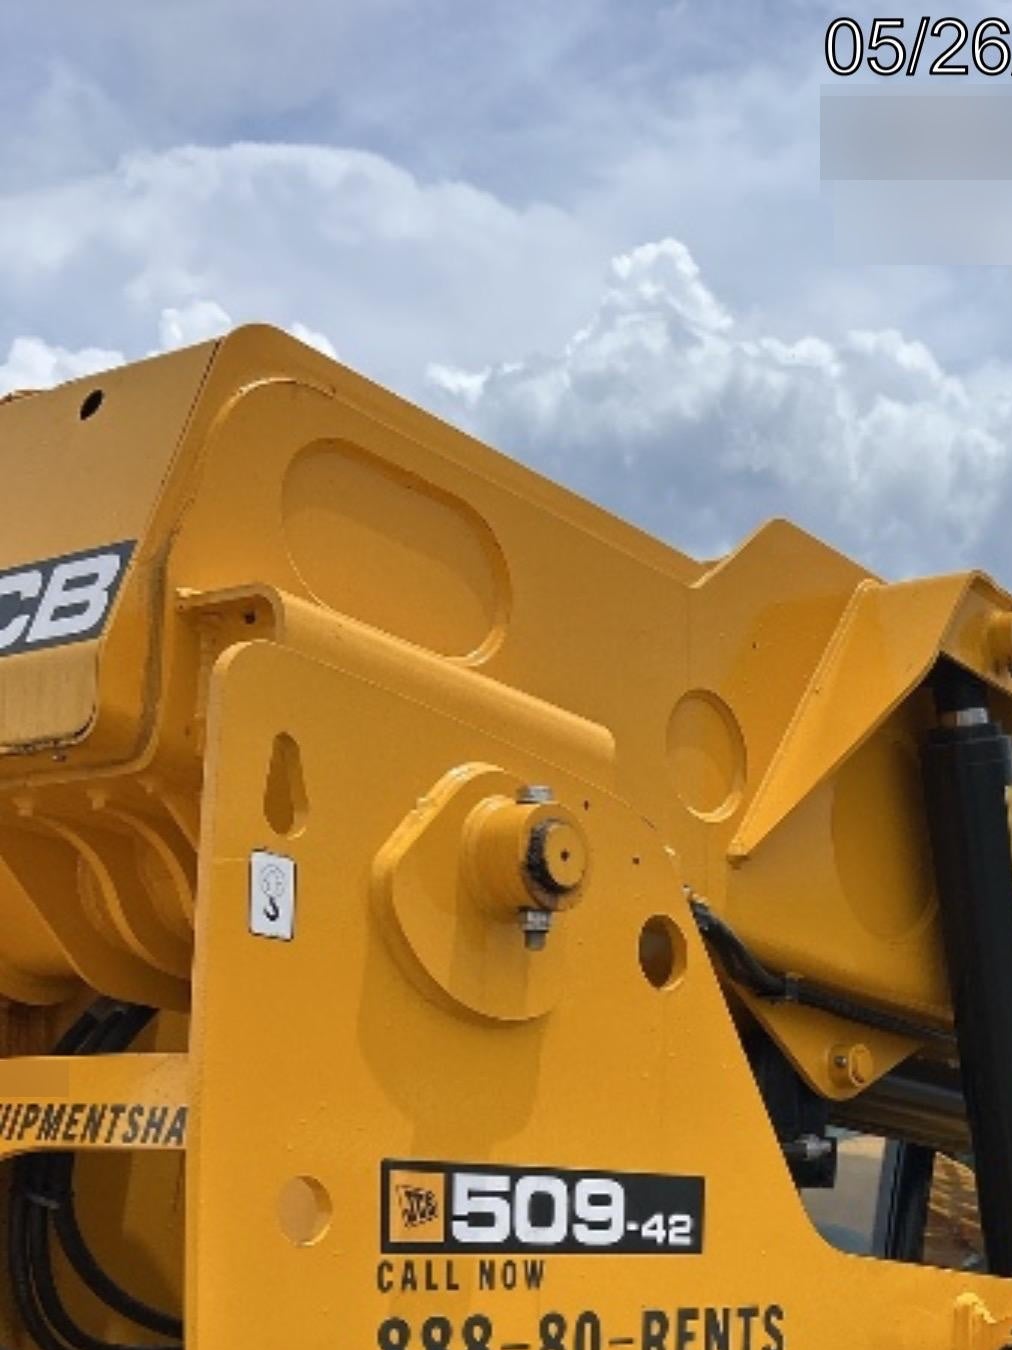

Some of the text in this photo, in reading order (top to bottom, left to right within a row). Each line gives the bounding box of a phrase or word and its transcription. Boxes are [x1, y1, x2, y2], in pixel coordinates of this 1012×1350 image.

[451, 1172, 693, 1246] 509-42
[376, 1259, 545, 1293] CALL NOW
